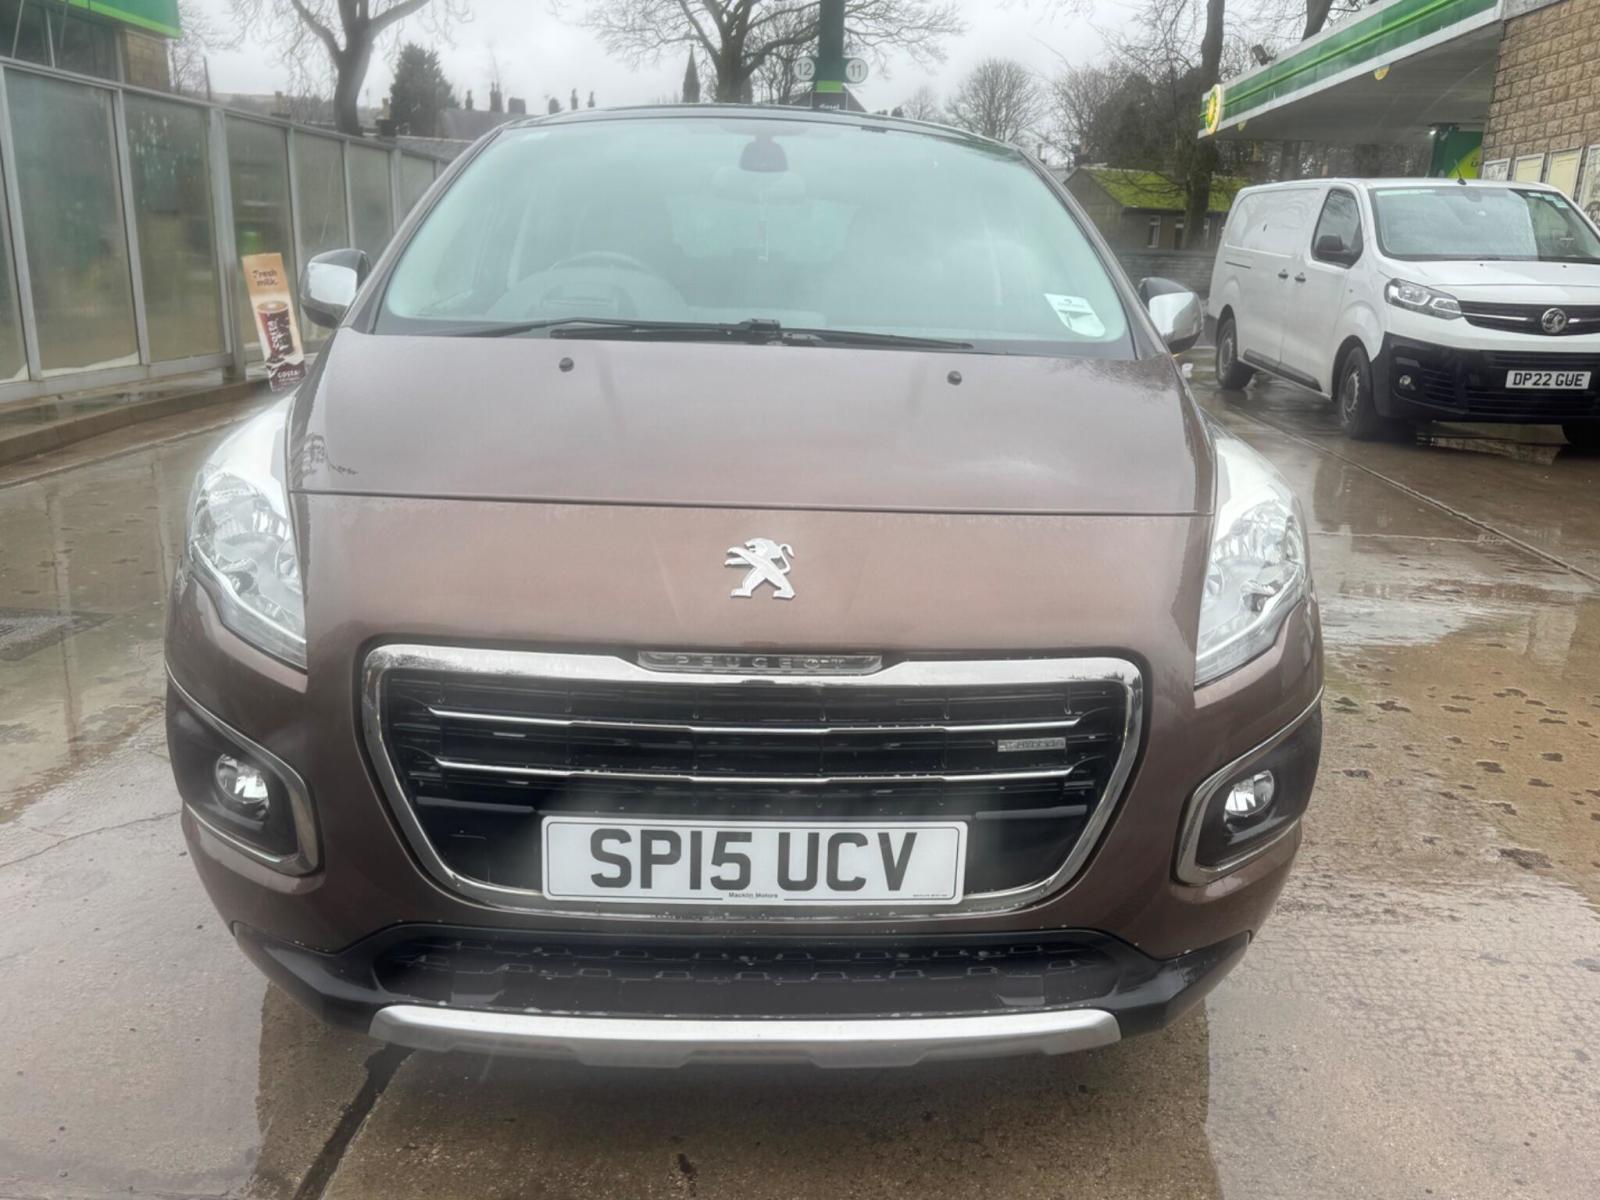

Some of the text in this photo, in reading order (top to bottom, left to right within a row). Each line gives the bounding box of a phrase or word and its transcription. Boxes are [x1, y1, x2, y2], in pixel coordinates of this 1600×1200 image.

[797, 62, 812, 76] 12
[850, 63, 862, 78] 11
[277, 370, 299, 378] COSTA
[1513, 372, 1585, 387] DP22 GUE
[589, 828, 918, 892] SP15 UCV
